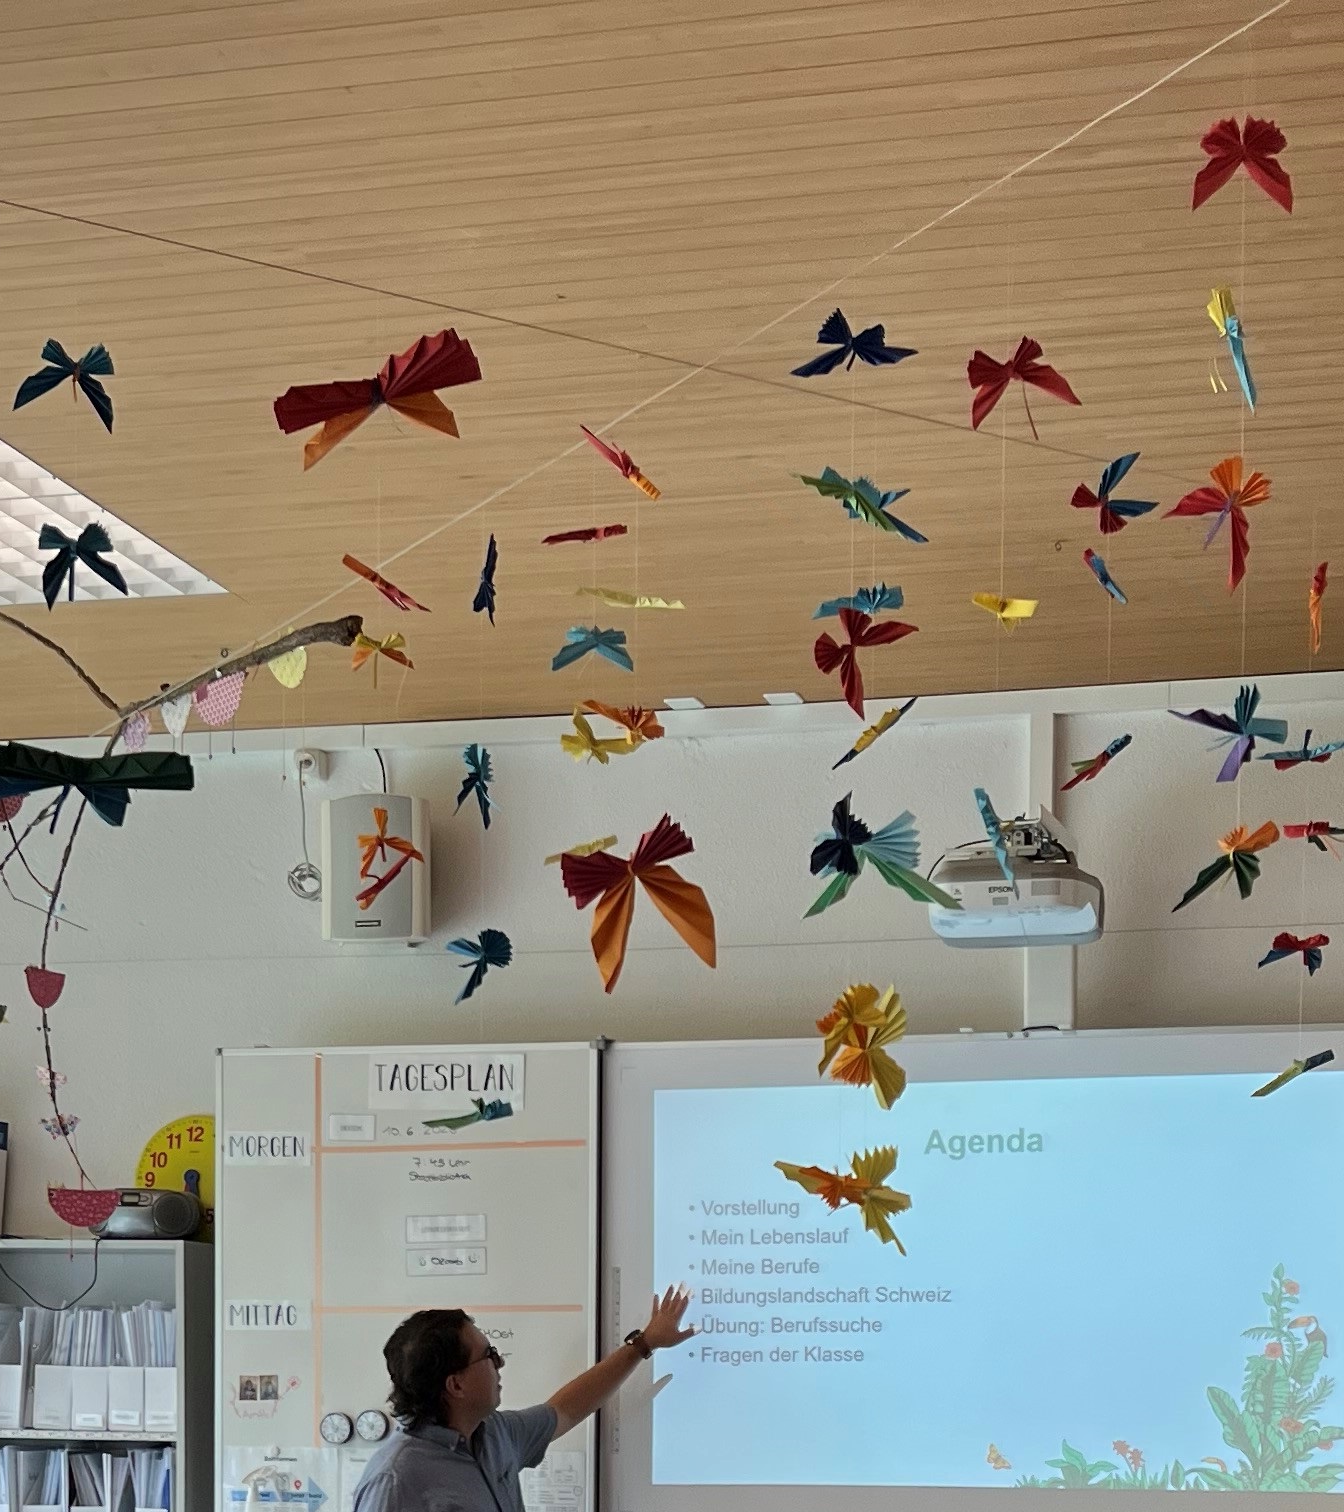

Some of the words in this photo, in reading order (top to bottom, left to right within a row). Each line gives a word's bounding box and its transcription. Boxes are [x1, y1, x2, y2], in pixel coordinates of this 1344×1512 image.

[375, 1062, 515, 1093] TAGESPLAN
[166, 1133, 182, 1149] 11
[186, 1126, 204, 1142] 12
[228, 1135, 306, 1159] MORGEN
[924, 1128, 1044, 1160] Agenda
[150, 1152, 168, 1168] 10
[144, 1172, 156, 1187] 9
[701, 1200, 800, 1219] Vorstellung
[701, 1228, 744, 1246] Mein
[750, 1227, 850, 1245] Lebenslauf
[701, 1258, 755, 1276] Meine
[761, 1257, 820, 1275] Berufe
[701, 1287, 870, 1307] Bildungslandschaft
[874, 1286, 952, 1304] Schweiz
[229, 1304, 297, 1326] MITTAG
[701, 1314, 765, 1336] Übung:
[771, 1316, 883, 1334] Berufssuche
[701, 1346, 764, 1366] Fragen
[769, 1346, 799, 1363] der
[804, 1346, 865, 1363] Klasse
